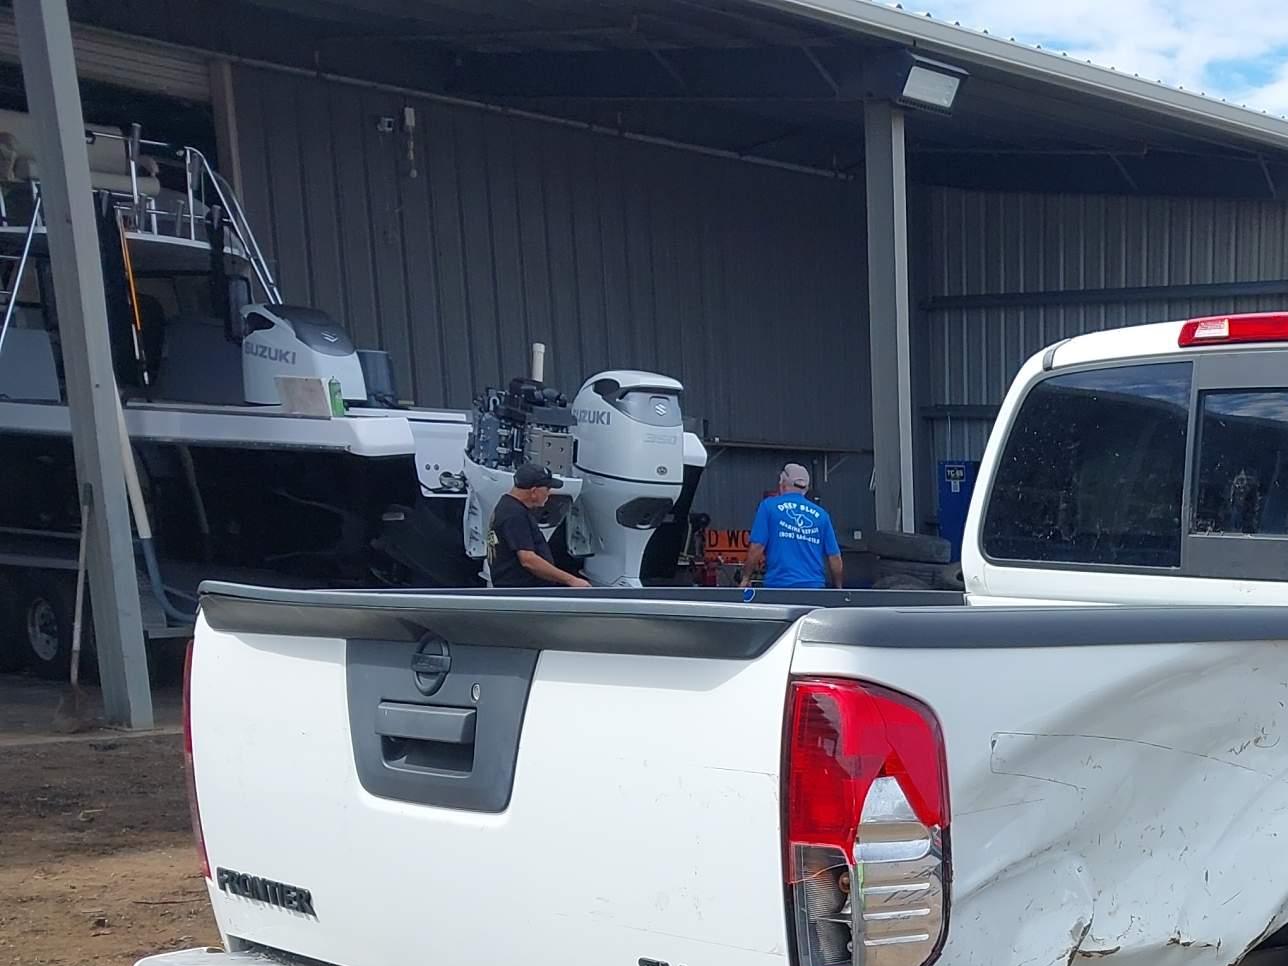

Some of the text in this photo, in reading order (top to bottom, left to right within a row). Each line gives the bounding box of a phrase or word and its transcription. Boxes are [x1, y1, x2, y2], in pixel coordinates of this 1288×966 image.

[244, 341, 297, 365] SUZUKI
[777, 502, 820, 518] DEEP BLUE
[216, 866, 318, 918] FRONTIER
